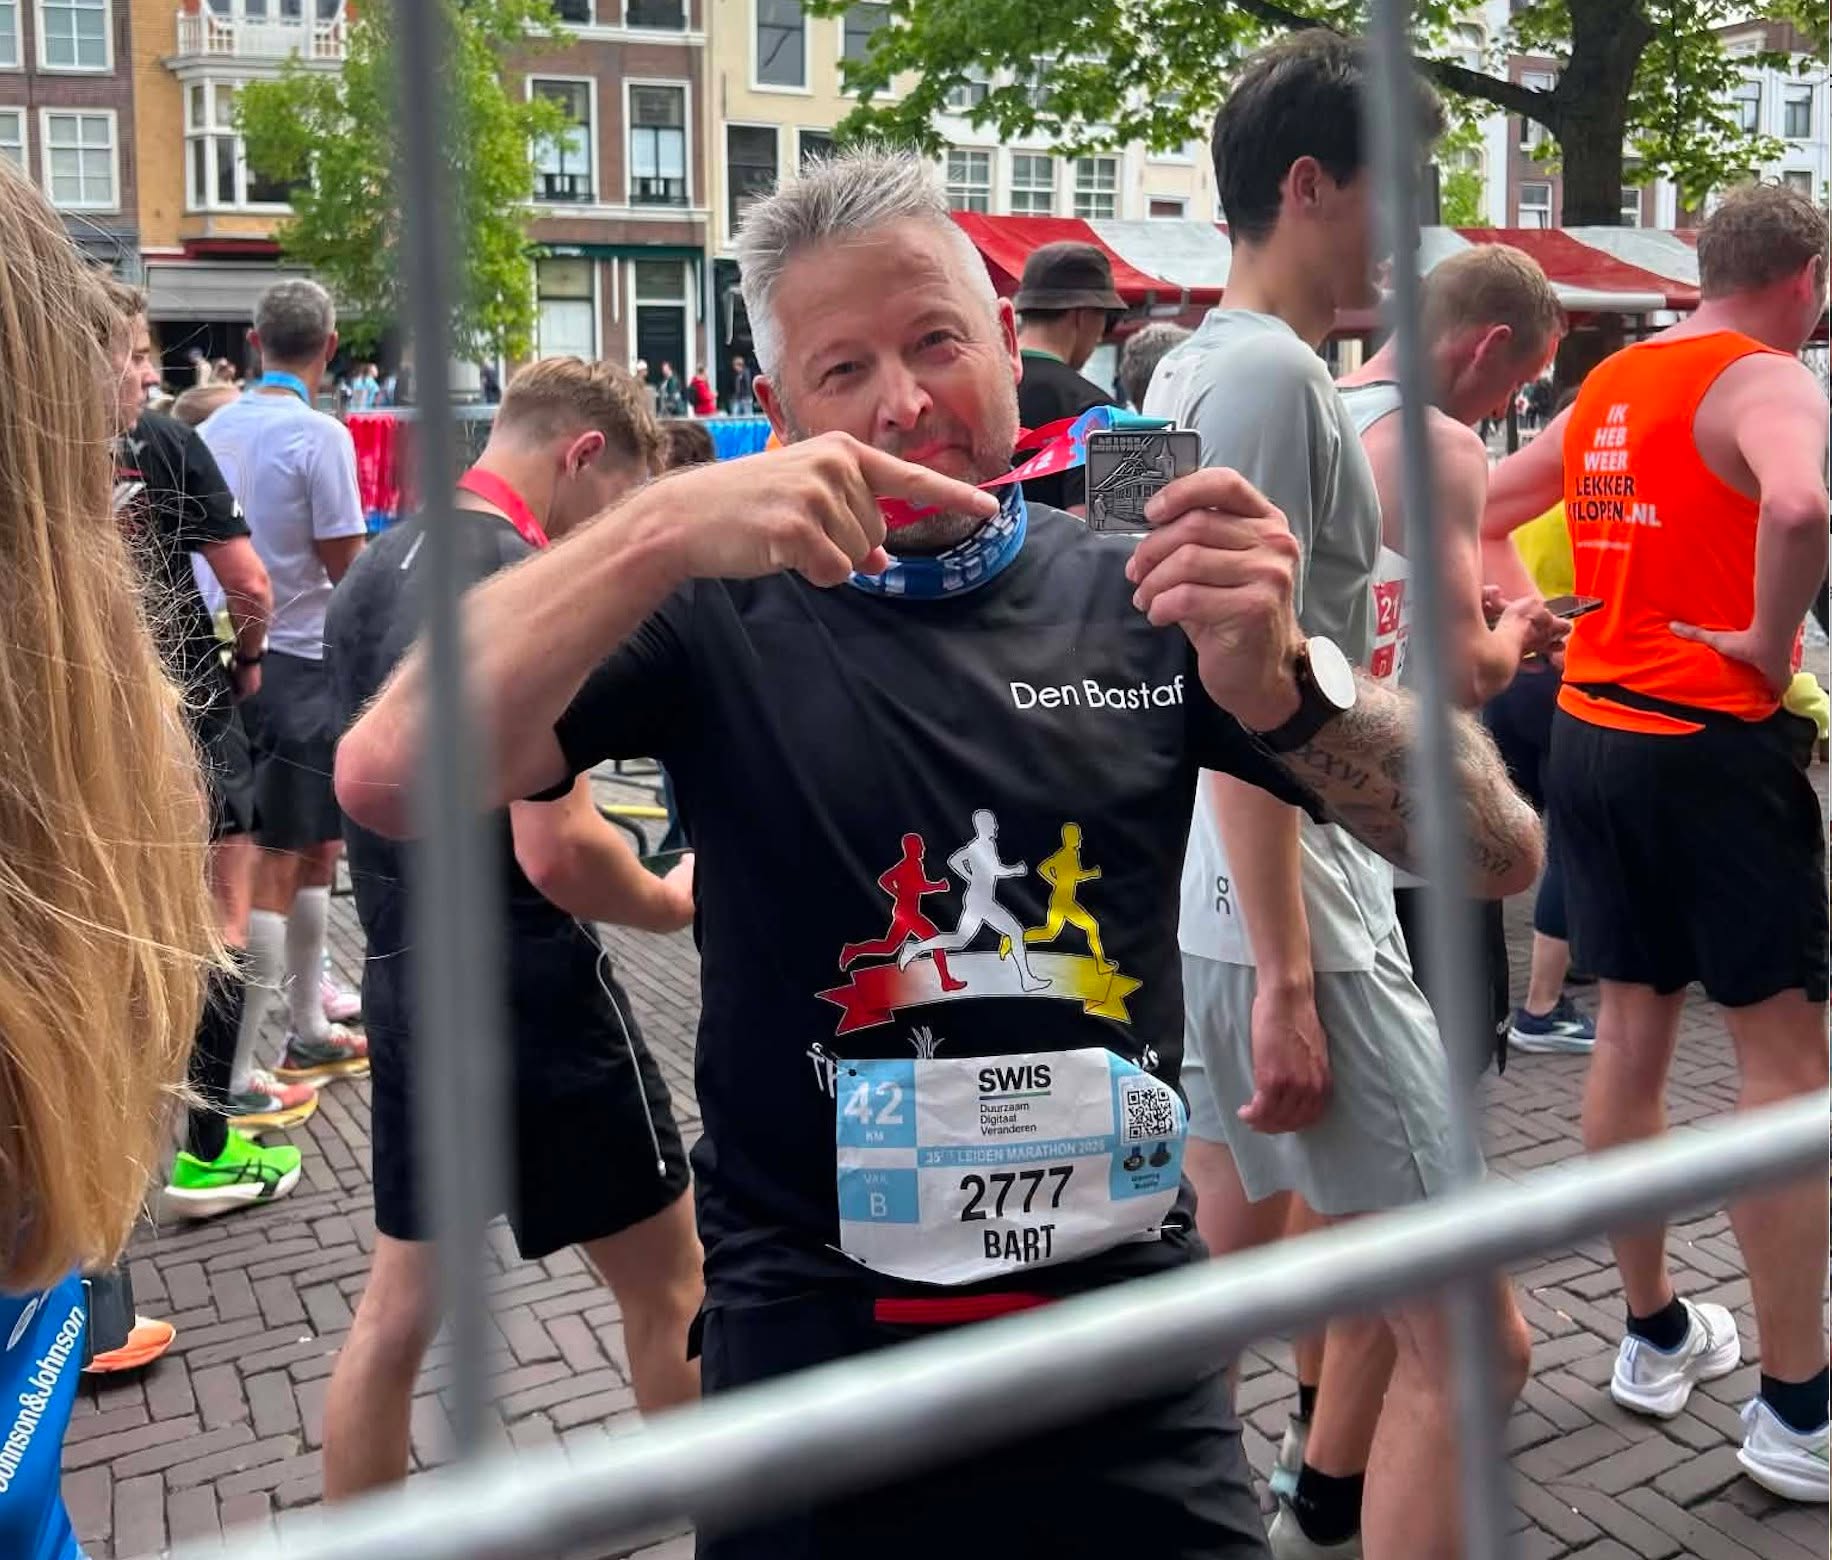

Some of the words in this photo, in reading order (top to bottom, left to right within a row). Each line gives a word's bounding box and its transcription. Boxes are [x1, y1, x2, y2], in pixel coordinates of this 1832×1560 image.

[1606, 403, 1630, 424] IK
[1593, 427, 1628, 448] HEB
[1584, 451, 1629, 472] WEER
[1576, 475, 1635, 497] LEKKER
[1009, 681, 1081, 709] Den
[978, 1064, 1052, 1093] SWIS
[843, 1081, 904, 1125] 42
[980, 1102, 1030, 1113] Duurzaam
[980, 1113, 1017, 1126] Digitaal
[980, 1123, 1037, 1136] Veranderen
[865, 1130, 884, 1143] KM
[957, 1147, 1004, 1162] LEIDEN
[1006, 1142, 1077, 1160] MARATHON
[869, 1191, 888, 1217] B
[959, 1165, 1075, 1222] 2777
[983, 1224, 1056, 1263] BART
